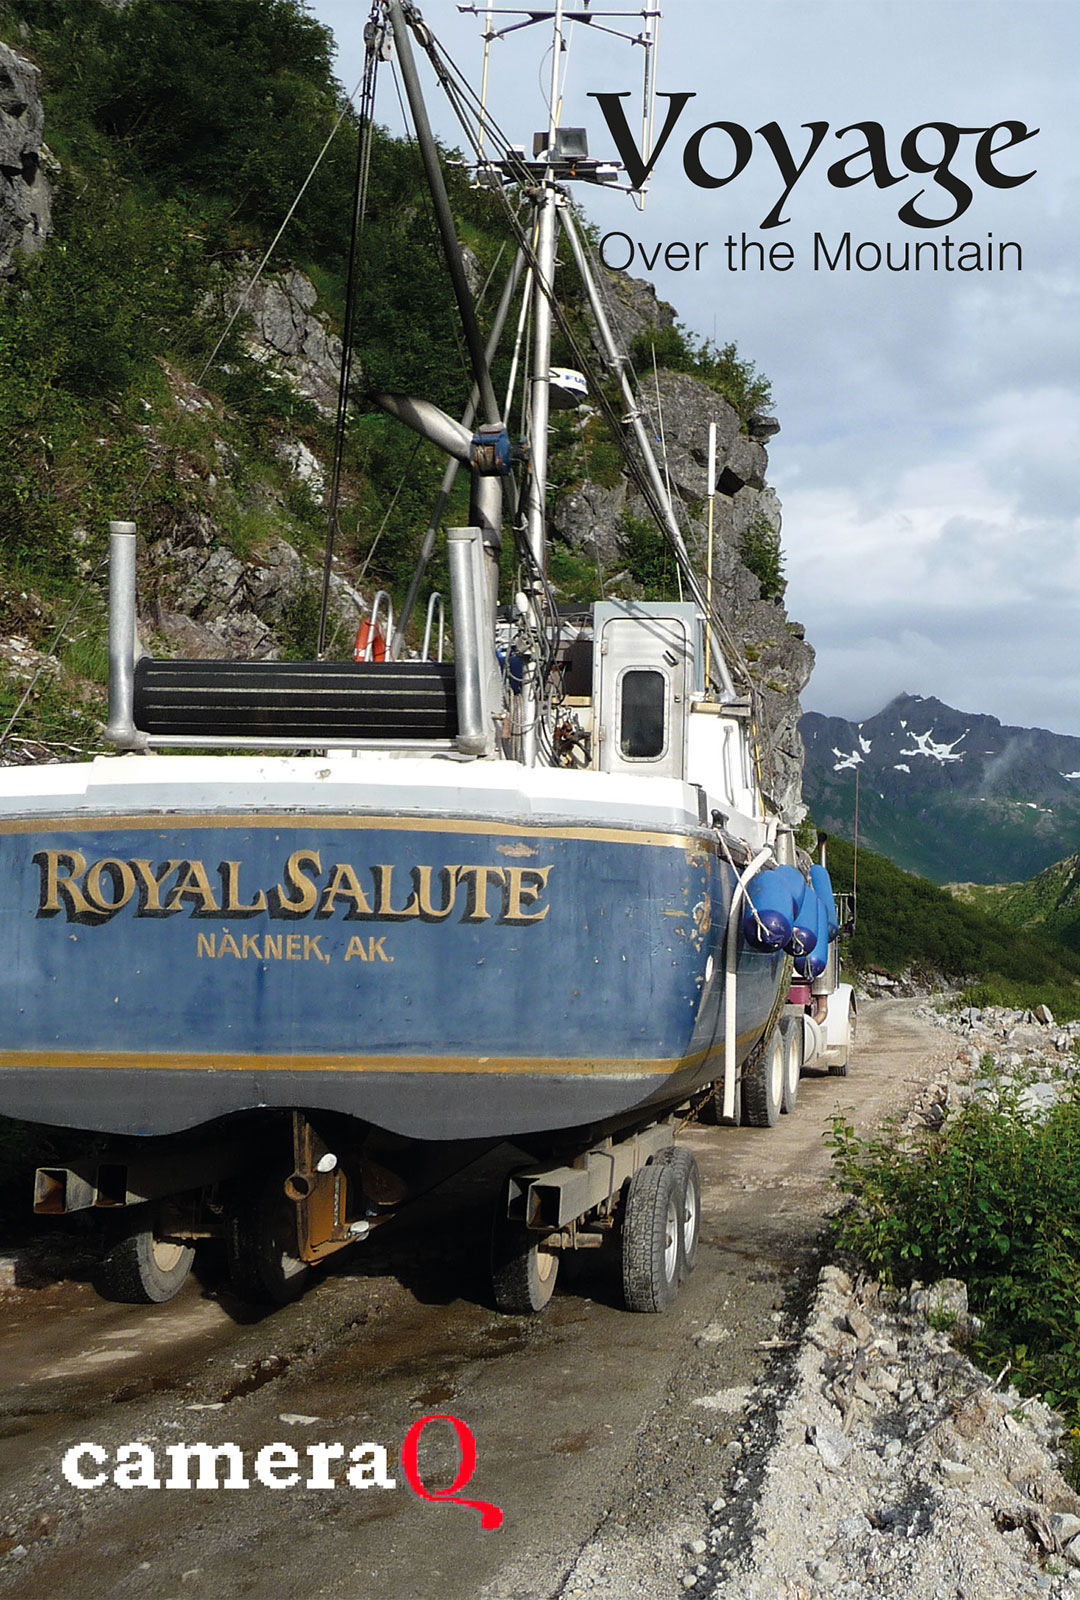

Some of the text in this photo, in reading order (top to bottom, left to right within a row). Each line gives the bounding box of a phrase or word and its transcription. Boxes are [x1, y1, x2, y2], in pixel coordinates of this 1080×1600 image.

[33, 848, 555, 927] ROYAL SALUTE
[343, 935, 396, 963] AK.
